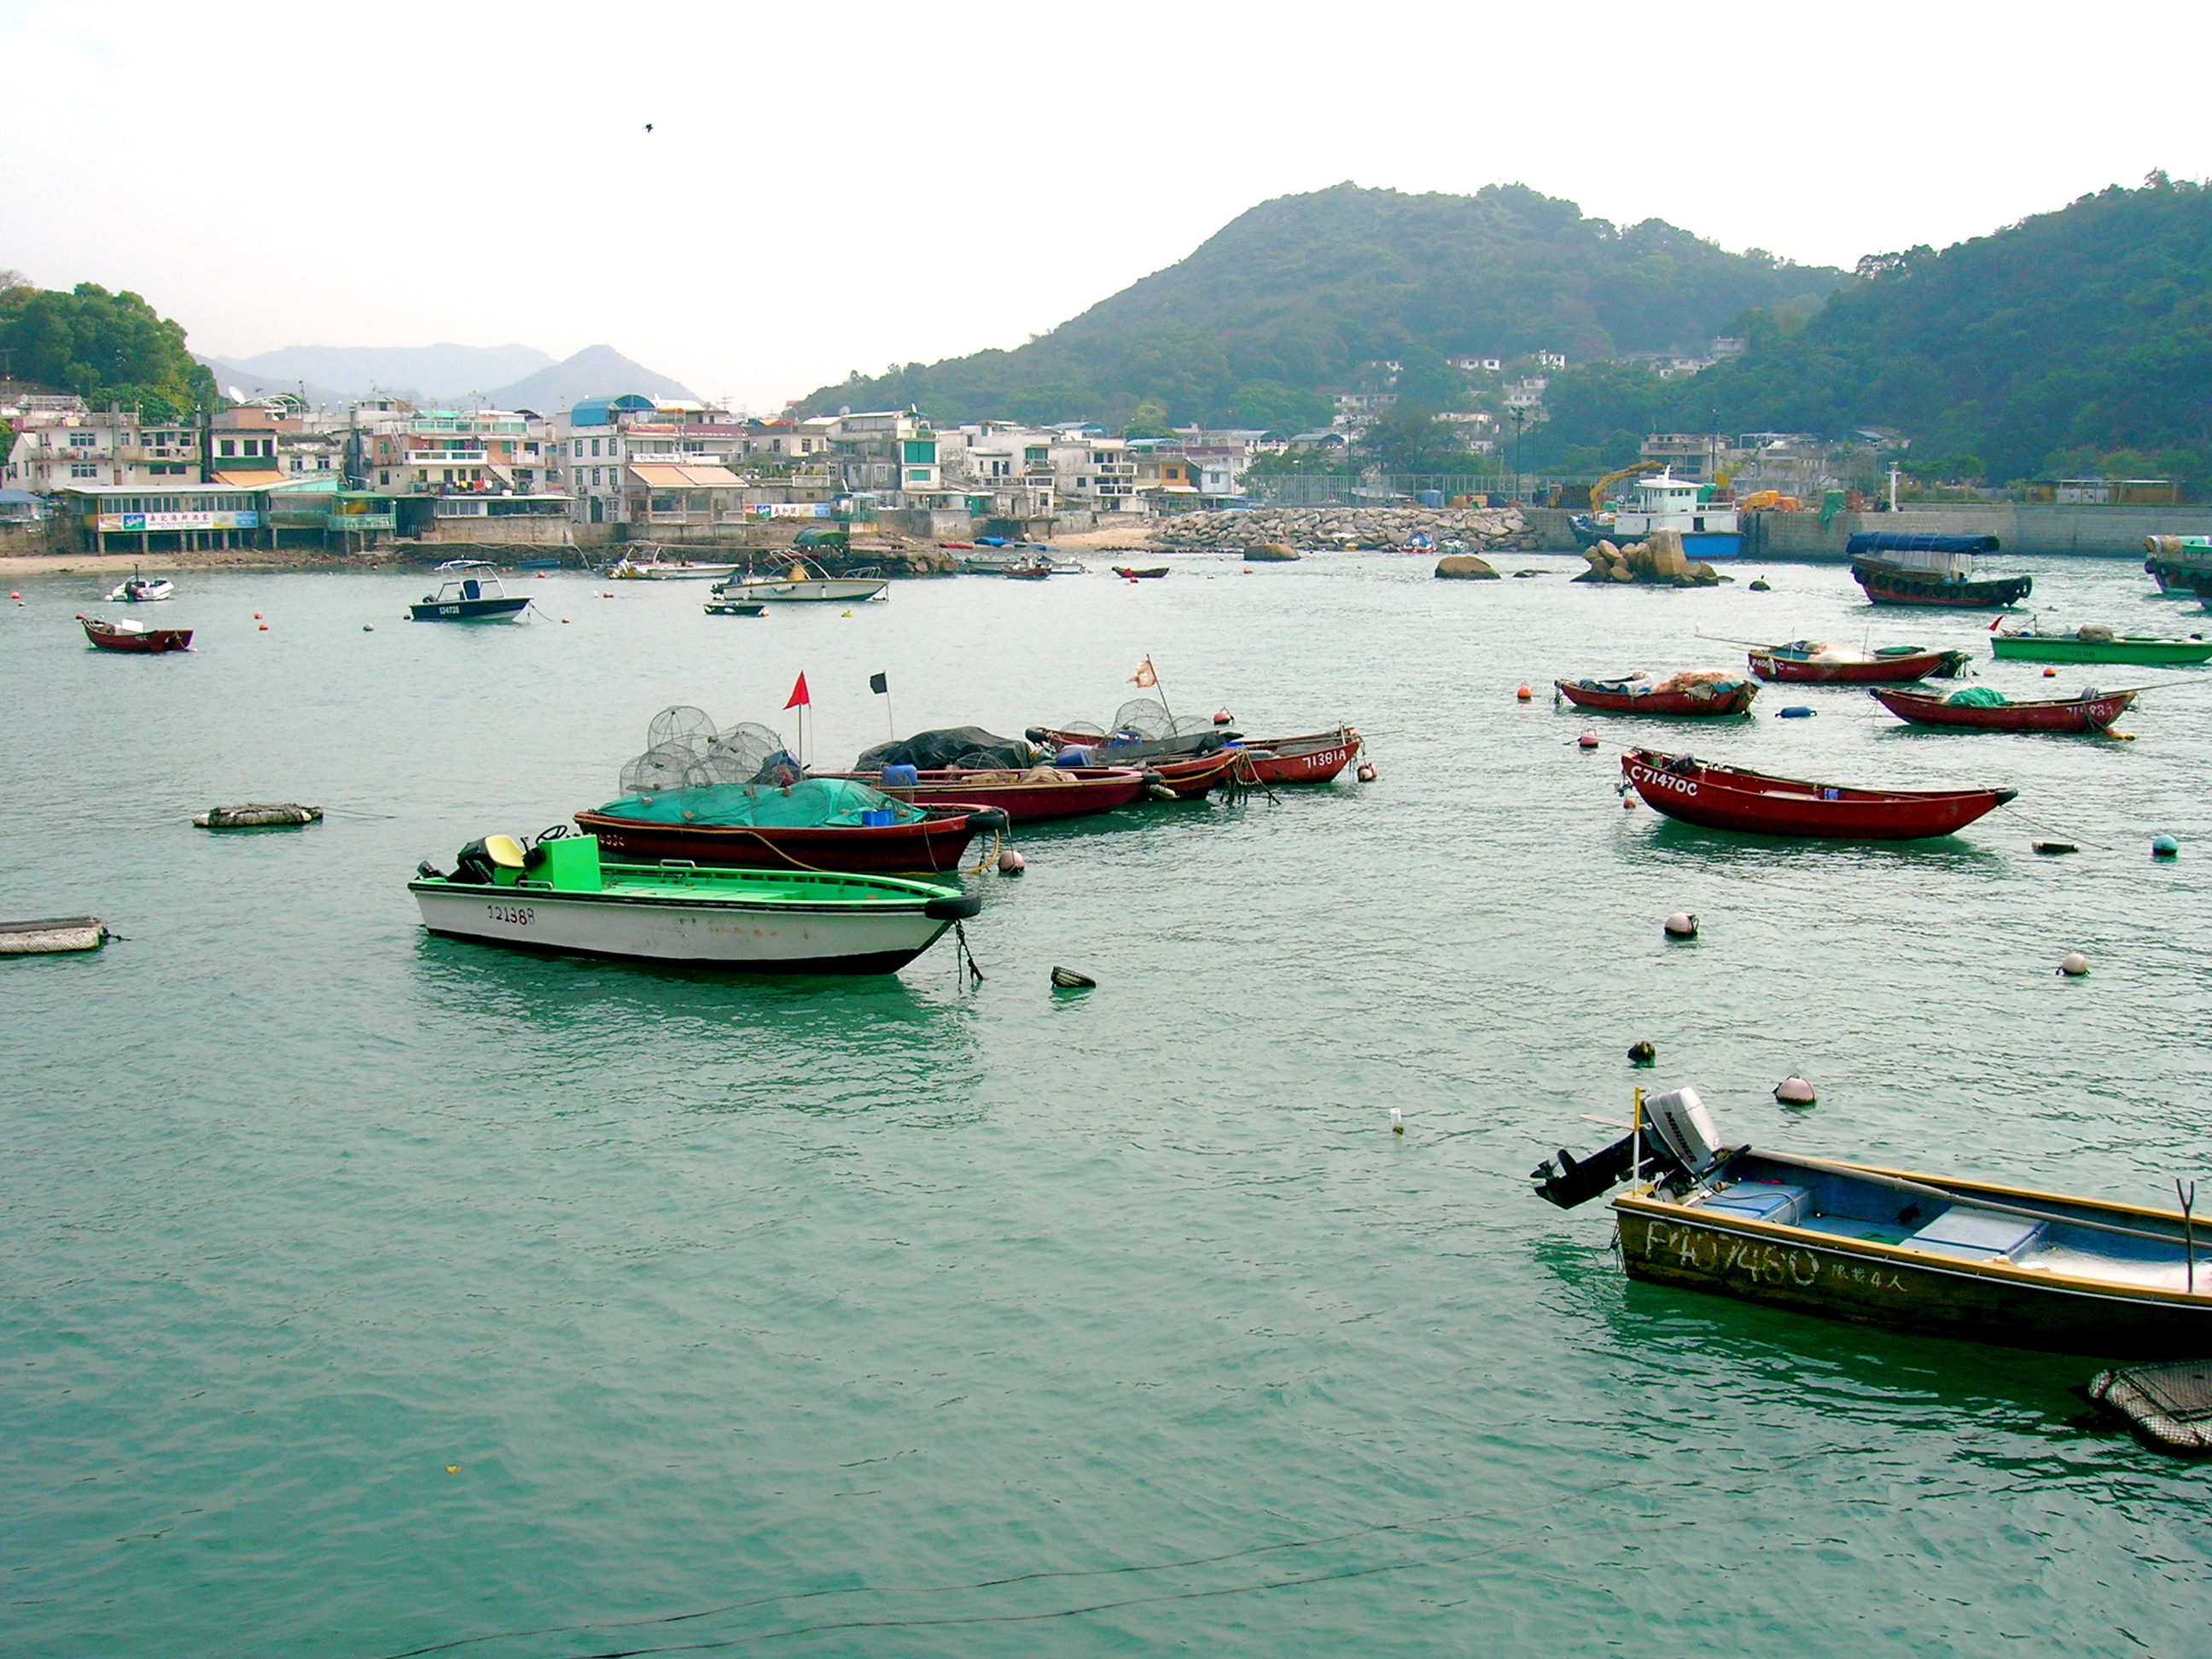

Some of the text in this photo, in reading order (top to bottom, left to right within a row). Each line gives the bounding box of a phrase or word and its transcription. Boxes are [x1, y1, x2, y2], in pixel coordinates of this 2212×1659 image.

[1302, 749, 1347, 768] 71381A
[487, 905, 535, 926] 121388
[1665, 1111, 1697, 1162] MARINER
